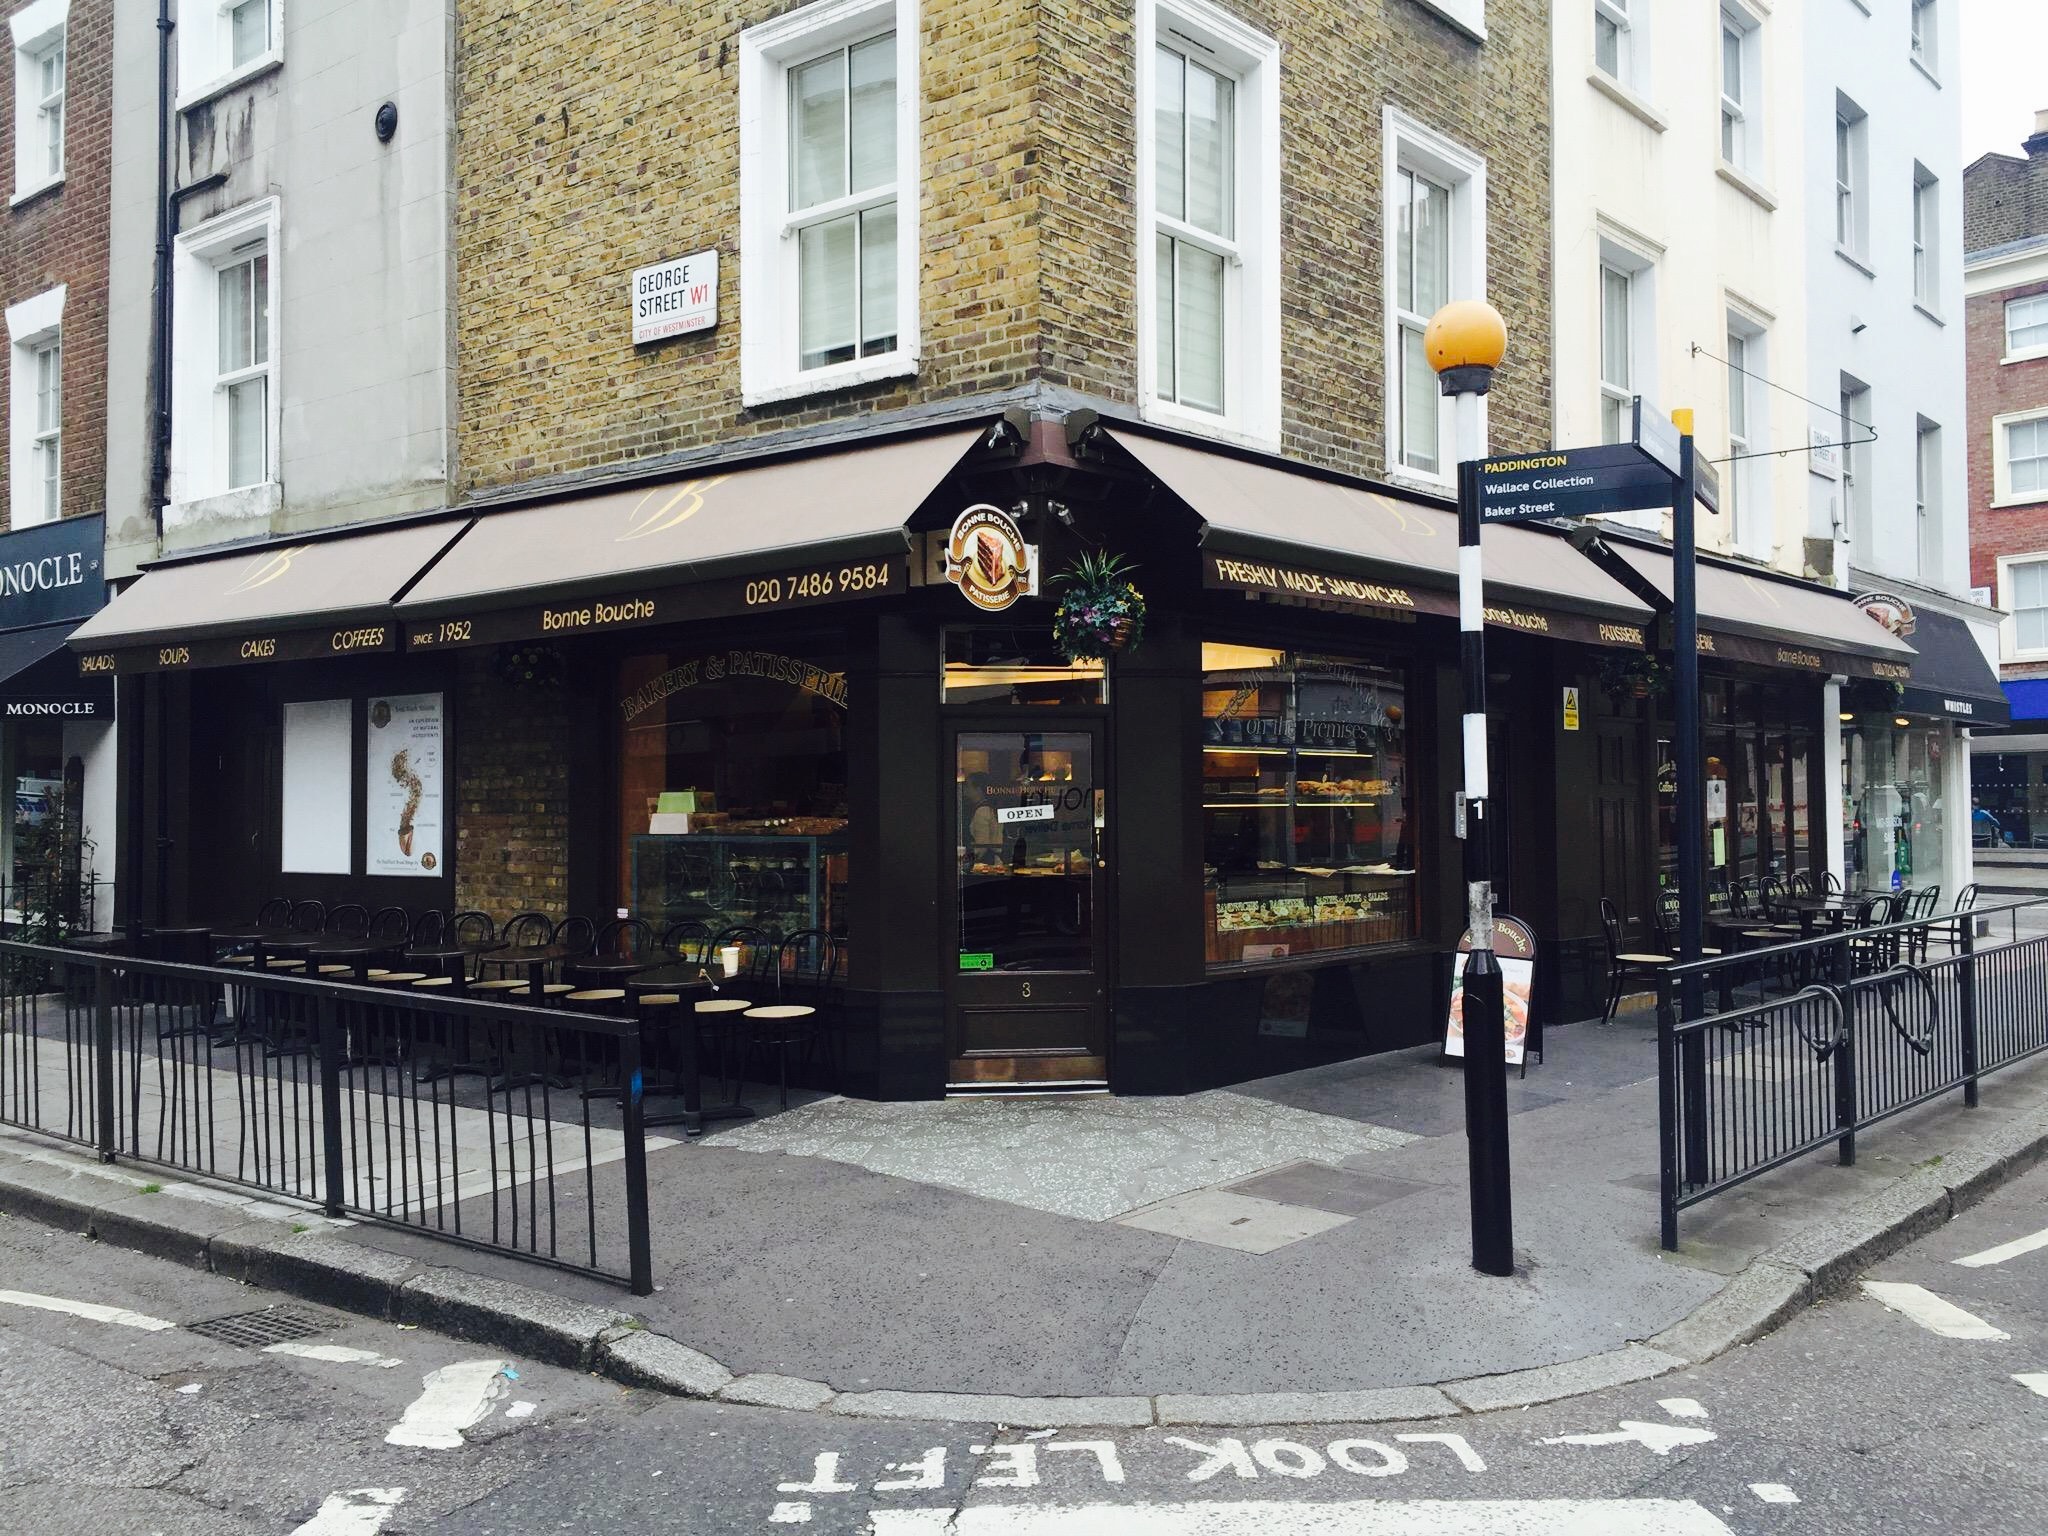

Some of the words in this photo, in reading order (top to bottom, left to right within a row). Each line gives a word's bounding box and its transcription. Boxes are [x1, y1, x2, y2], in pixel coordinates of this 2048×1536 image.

[640, 265, 690, 294] GEORGE
[640, 289, 685, 318] STREET
[690, 284, 708, 305] W1
[639, 328, 652, 339] CITY
[653, 327, 661, 336] OF
[663, 316, 706, 333] WESTMINSTER
[1484, 455, 1567, 474] PADDINGTON
[1485, 481, 1530, 495] Wallace
[1532, 475, 1594, 490] Collection
[1484, 505, 1516, 517] Baker
[1520, 501, 1555, 515] Street
[956, 512, 986, 541] BONNE
[987, 513, 1022, 552] BOUCHE
[0, 552, 83, 597] NOCLE
[745, 579, 781, 605] 020
[787, 572, 834, 600] 7486
[839, 563, 889, 592] 9584
[1215, 559, 1278, 588] FRESHLY
[1279, 569, 1327, 595] MADE
[968, 584, 1011, 604] PATISSERIE
[543, 609, 591, 630] Bonne
[595, 598, 655, 624] Bouche
[1483, 607, 1512, 625] onne
[1511, 608, 1549, 632] Bouche
[332, 627, 385, 650] COFFEES
[439, 620, 472, 642] 1952
[1599, 624, 1643, 645] PATISSERIE
[159, 647, 190, 665] SOUPS
[241, 638, 276, 658] CAKES
[82, 654, 115, 672] SALADS
[620, 660, 700, 721] BAKERY
[705, 655, 726, 680] &
[6, 702, 95, 715] MONOCLE
[1944, 699, 1973, 715] WHISTLES
[1302, 718, 1369, 742] Premises
[1006, 808, 1044, 820] OPEN
[1473, 800, 1483, 820] 1
[1498, 922, 1527, 953] Bouche
[1022, 982, 1031, 998] 3
[776, 1439, 1126, 1493] LEFT
[1164, 1432, 1488, 1483] LOOK
